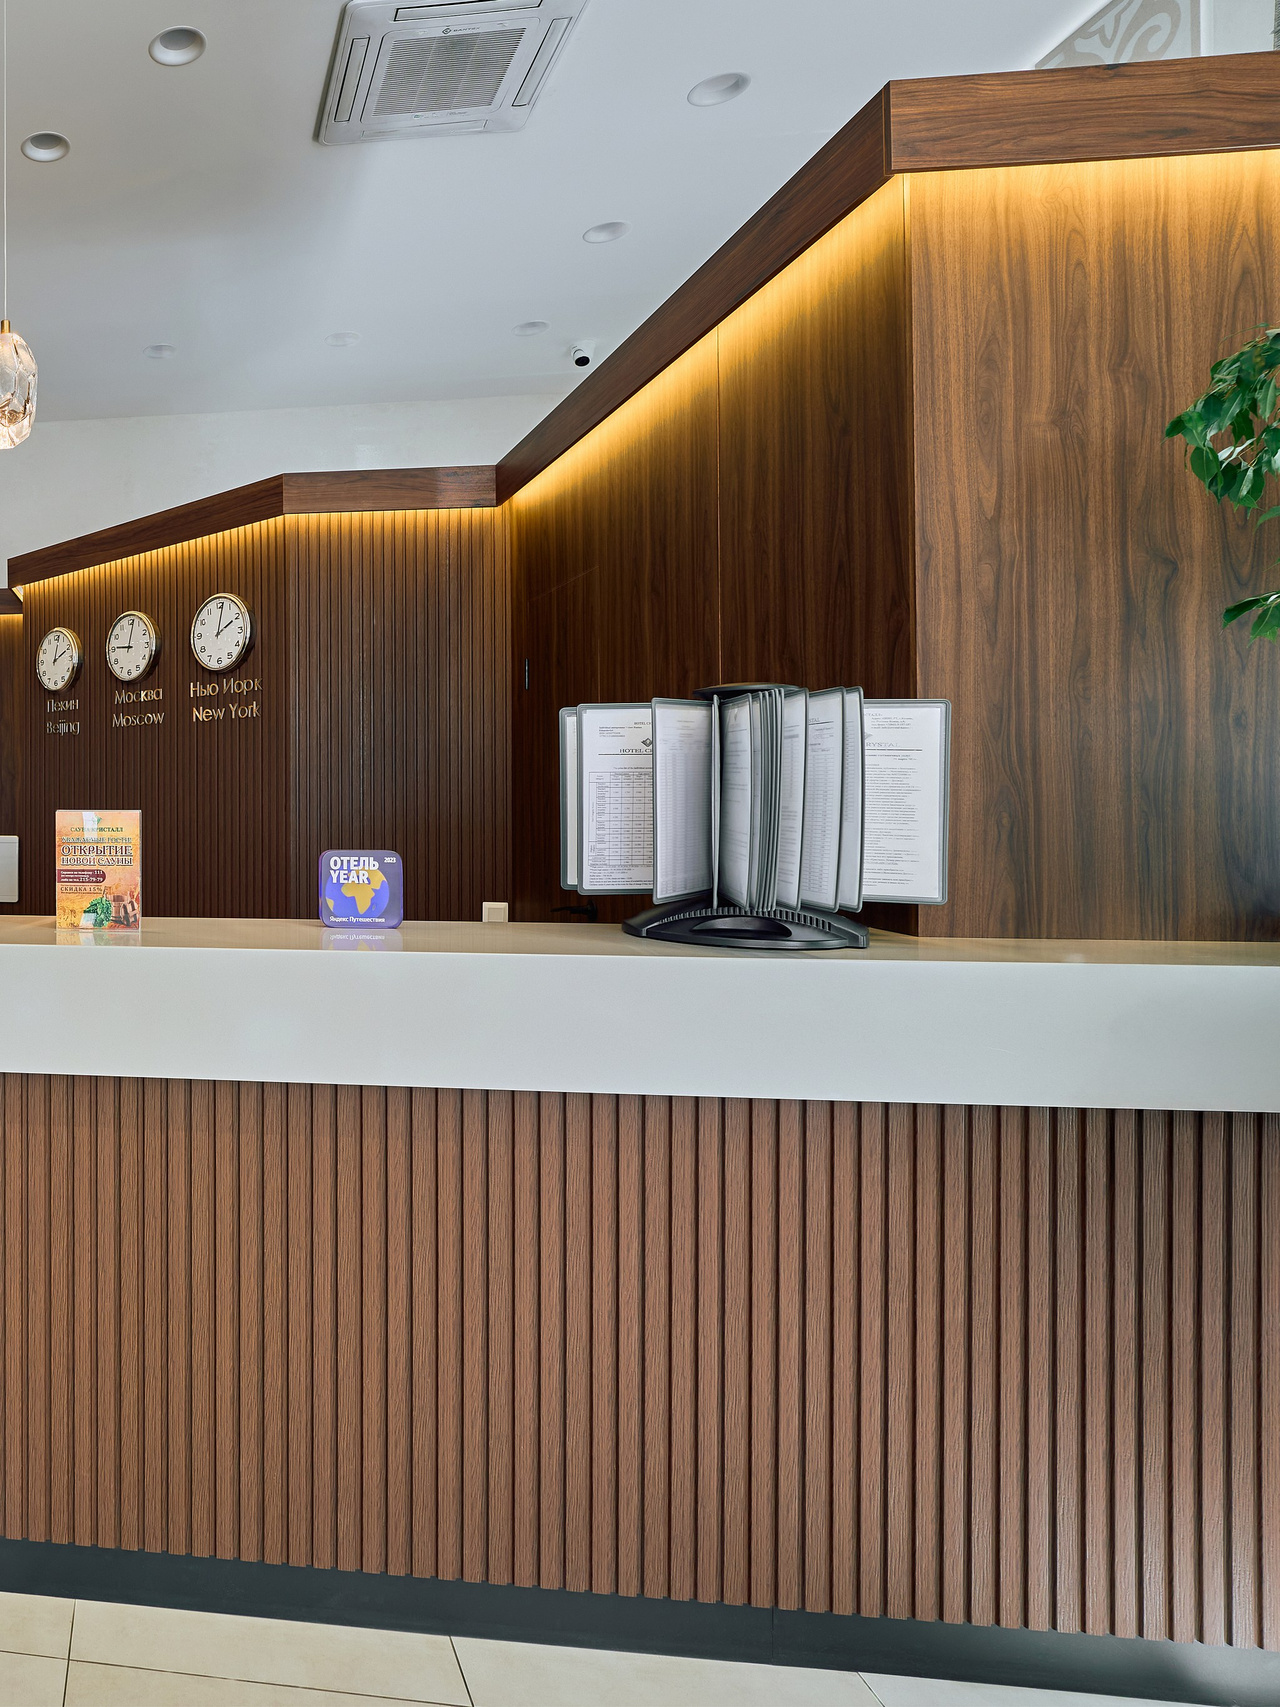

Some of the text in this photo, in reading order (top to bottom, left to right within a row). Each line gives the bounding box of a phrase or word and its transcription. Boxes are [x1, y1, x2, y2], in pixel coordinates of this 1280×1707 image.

[114, 688, 163, 705] Москва
[190, 681, 219, 698] Нью
[47, 699, 79, 713] Пекин
[192, 700, 261, 722] New York
[112, 712, 165, 728] Moscow
[46, 719, 80, 736] Beijing
[61, 845, 133, 856] ОТКРЫТИЕ
[61, 855, 133, 866] НОВОЙ САУНЫ
[329, 856, 380, 870] ОТЕЛЬ
[329, 870, 369, 884] YEAR
[329, 915, 349, 923] Яндекс
